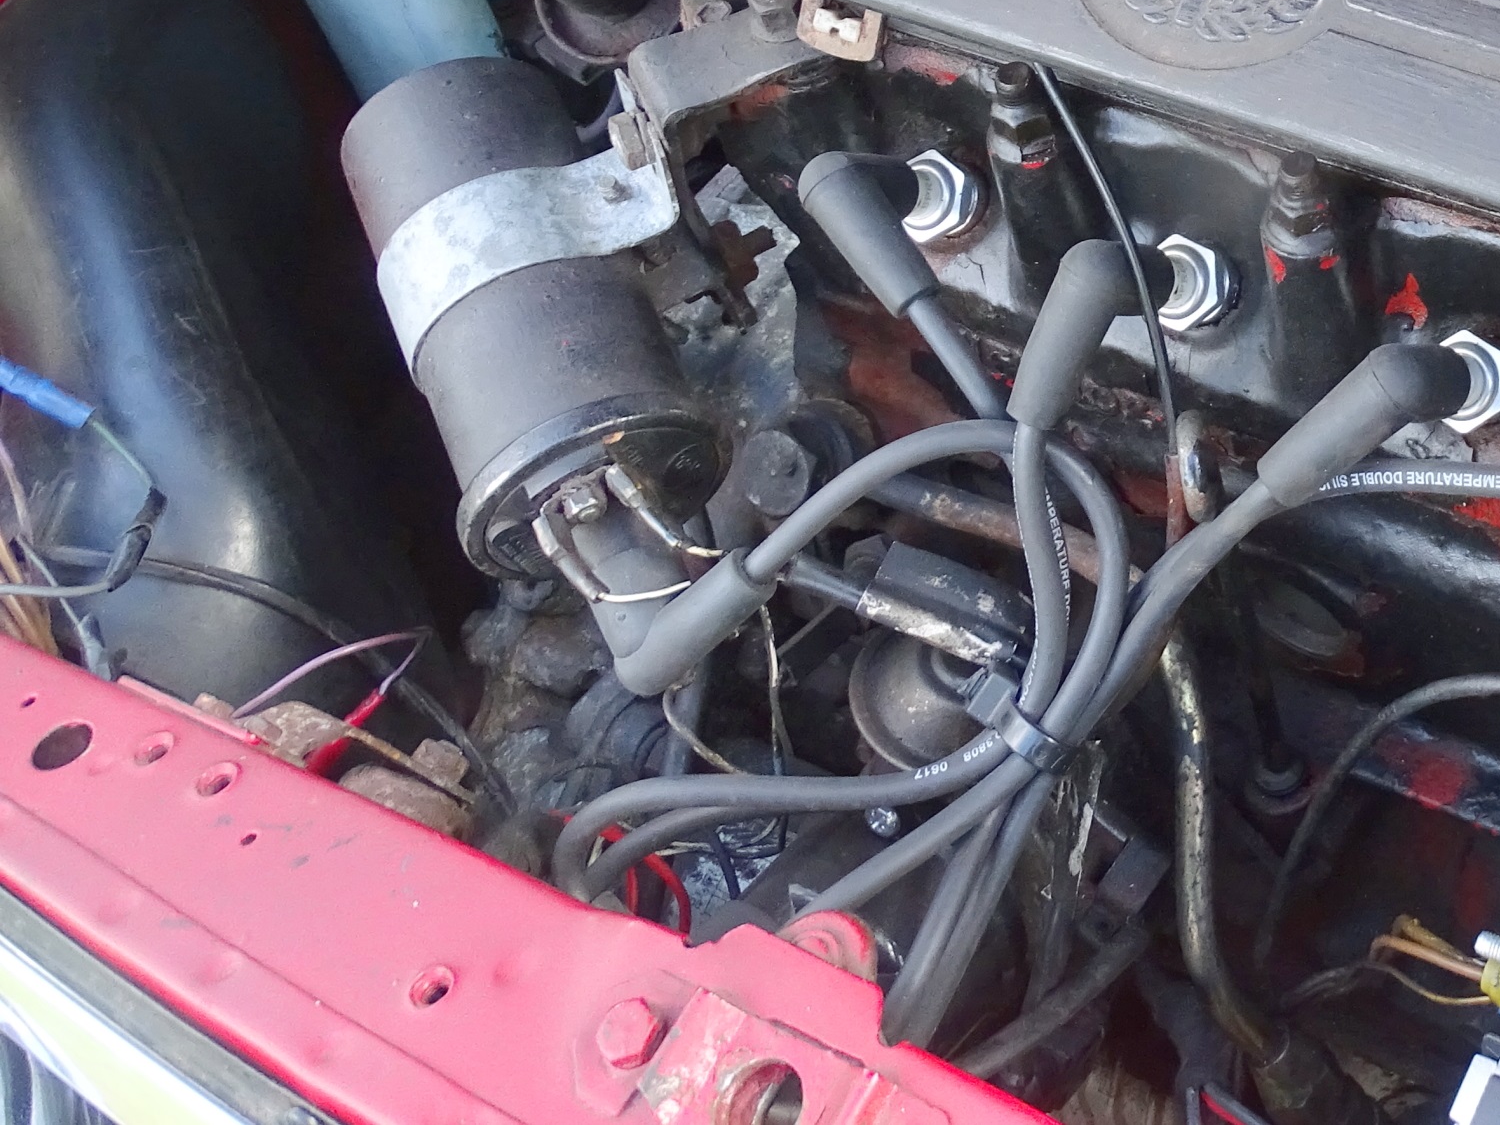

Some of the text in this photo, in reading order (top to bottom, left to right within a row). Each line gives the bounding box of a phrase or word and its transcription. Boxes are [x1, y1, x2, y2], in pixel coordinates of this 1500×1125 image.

[1350, 470, 1404, 487] DOUBLE
[913, 736, 994, 781] 3808 0617
